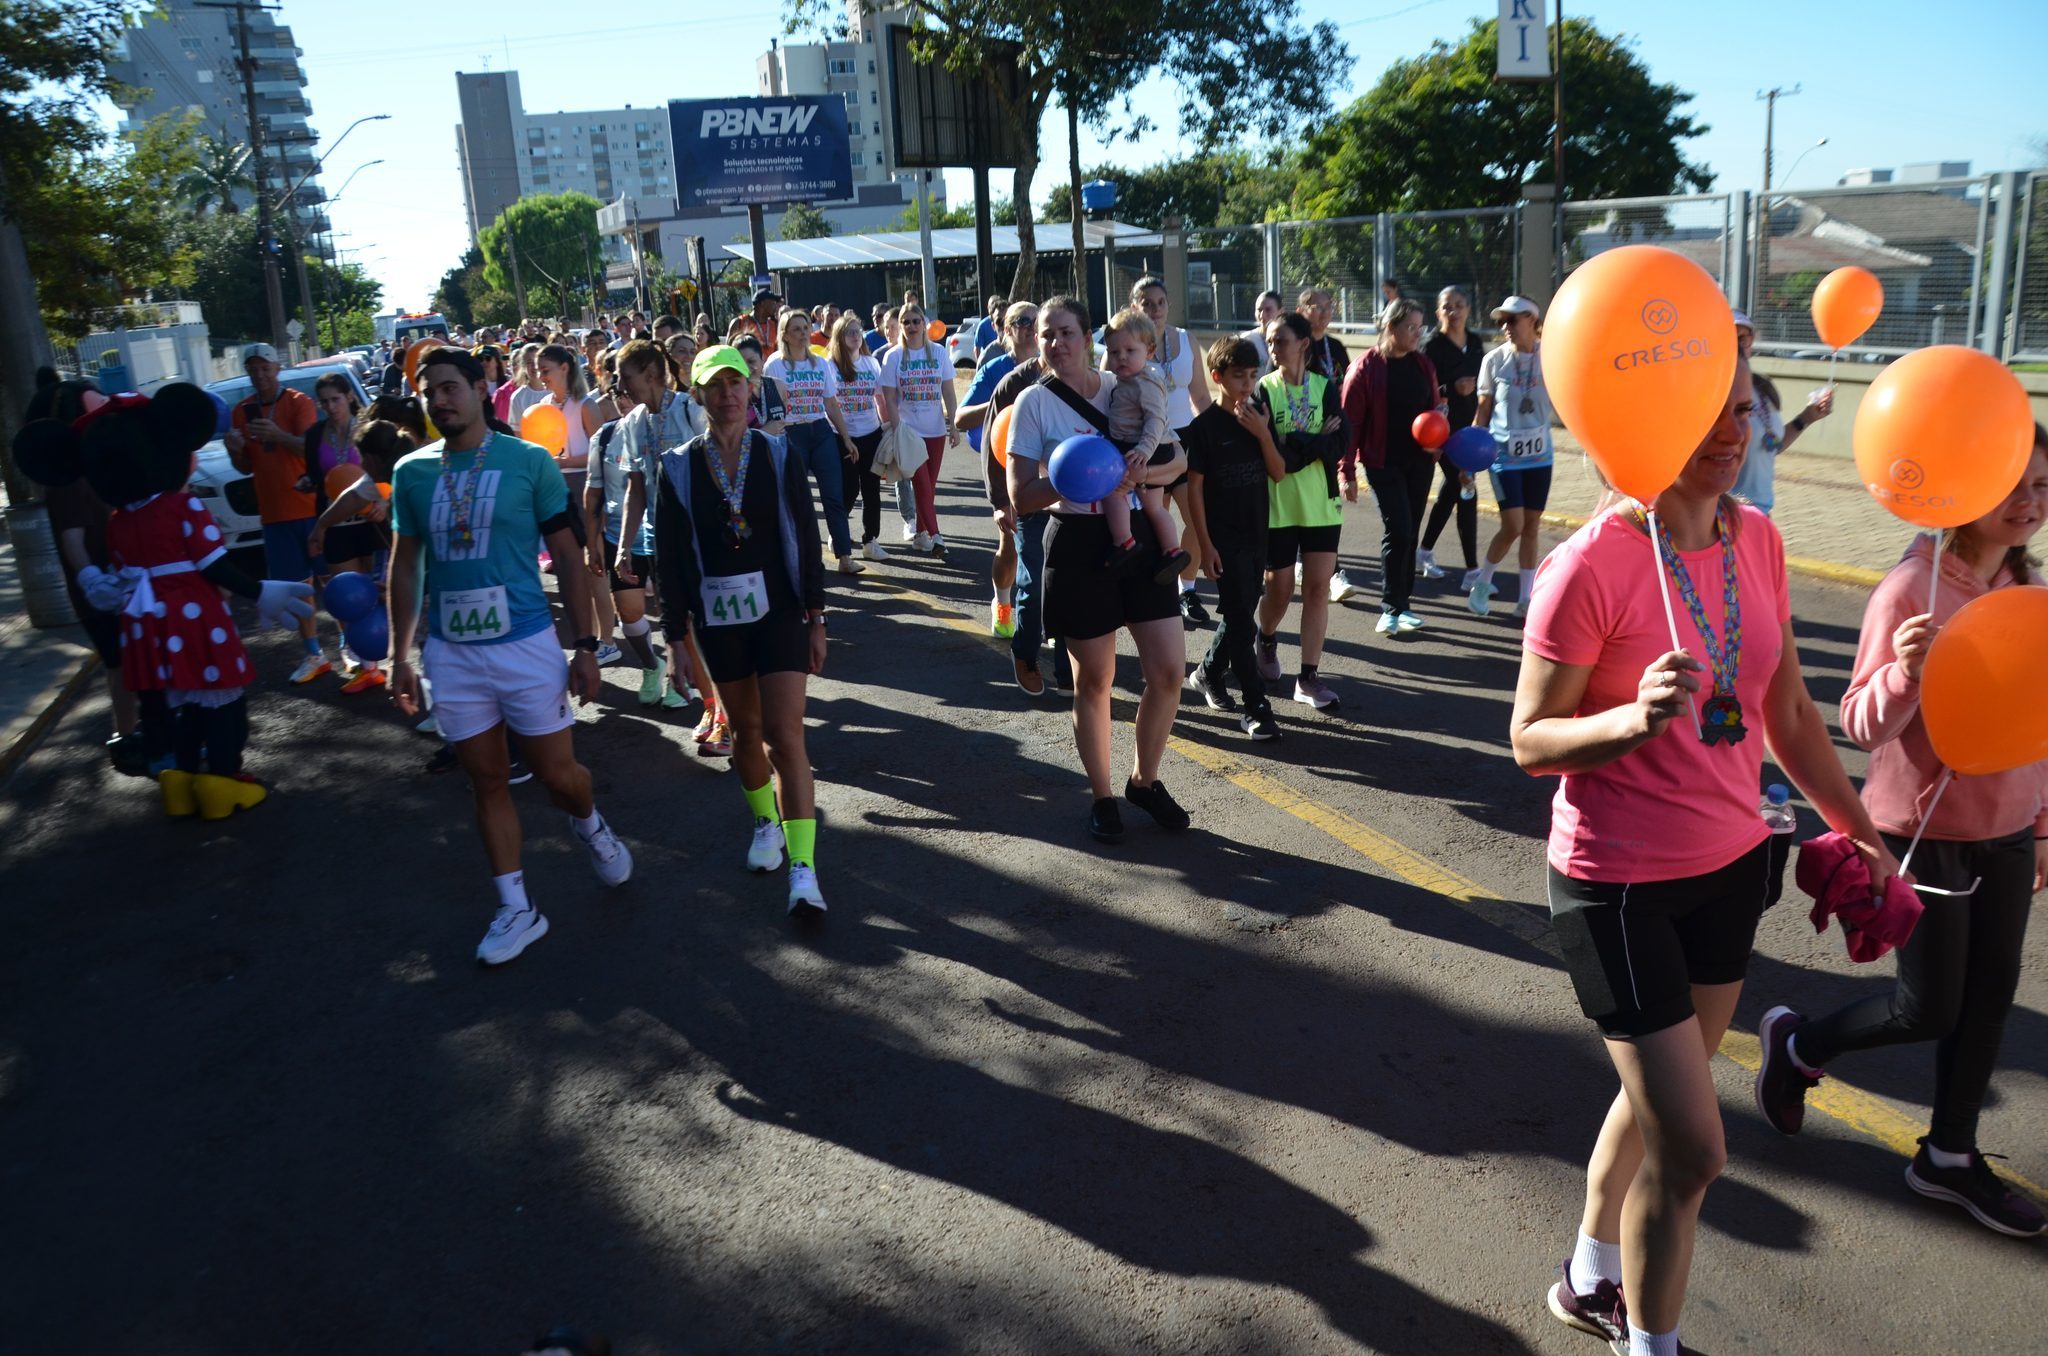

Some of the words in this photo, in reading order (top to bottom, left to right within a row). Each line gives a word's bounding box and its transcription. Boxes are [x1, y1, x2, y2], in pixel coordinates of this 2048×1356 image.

[700, 105, 818, 138] PBNEW
[730, 136, 822, 150] SISTEMAS
[723, 157, 756, 169] Soluções
[757, 154, 803, 166] tecnológicas
[737, 164, 768, 175] produtos
[1614, 339, 1713, 371] CRESOL
[900, 359, 939, 371] JUNTOS
[794, 381, 808, 389] POR
[1514, 437, 1543, 456] 810
[713, 591, 758, 621] 411
[449, 606, 501, 637] 444
